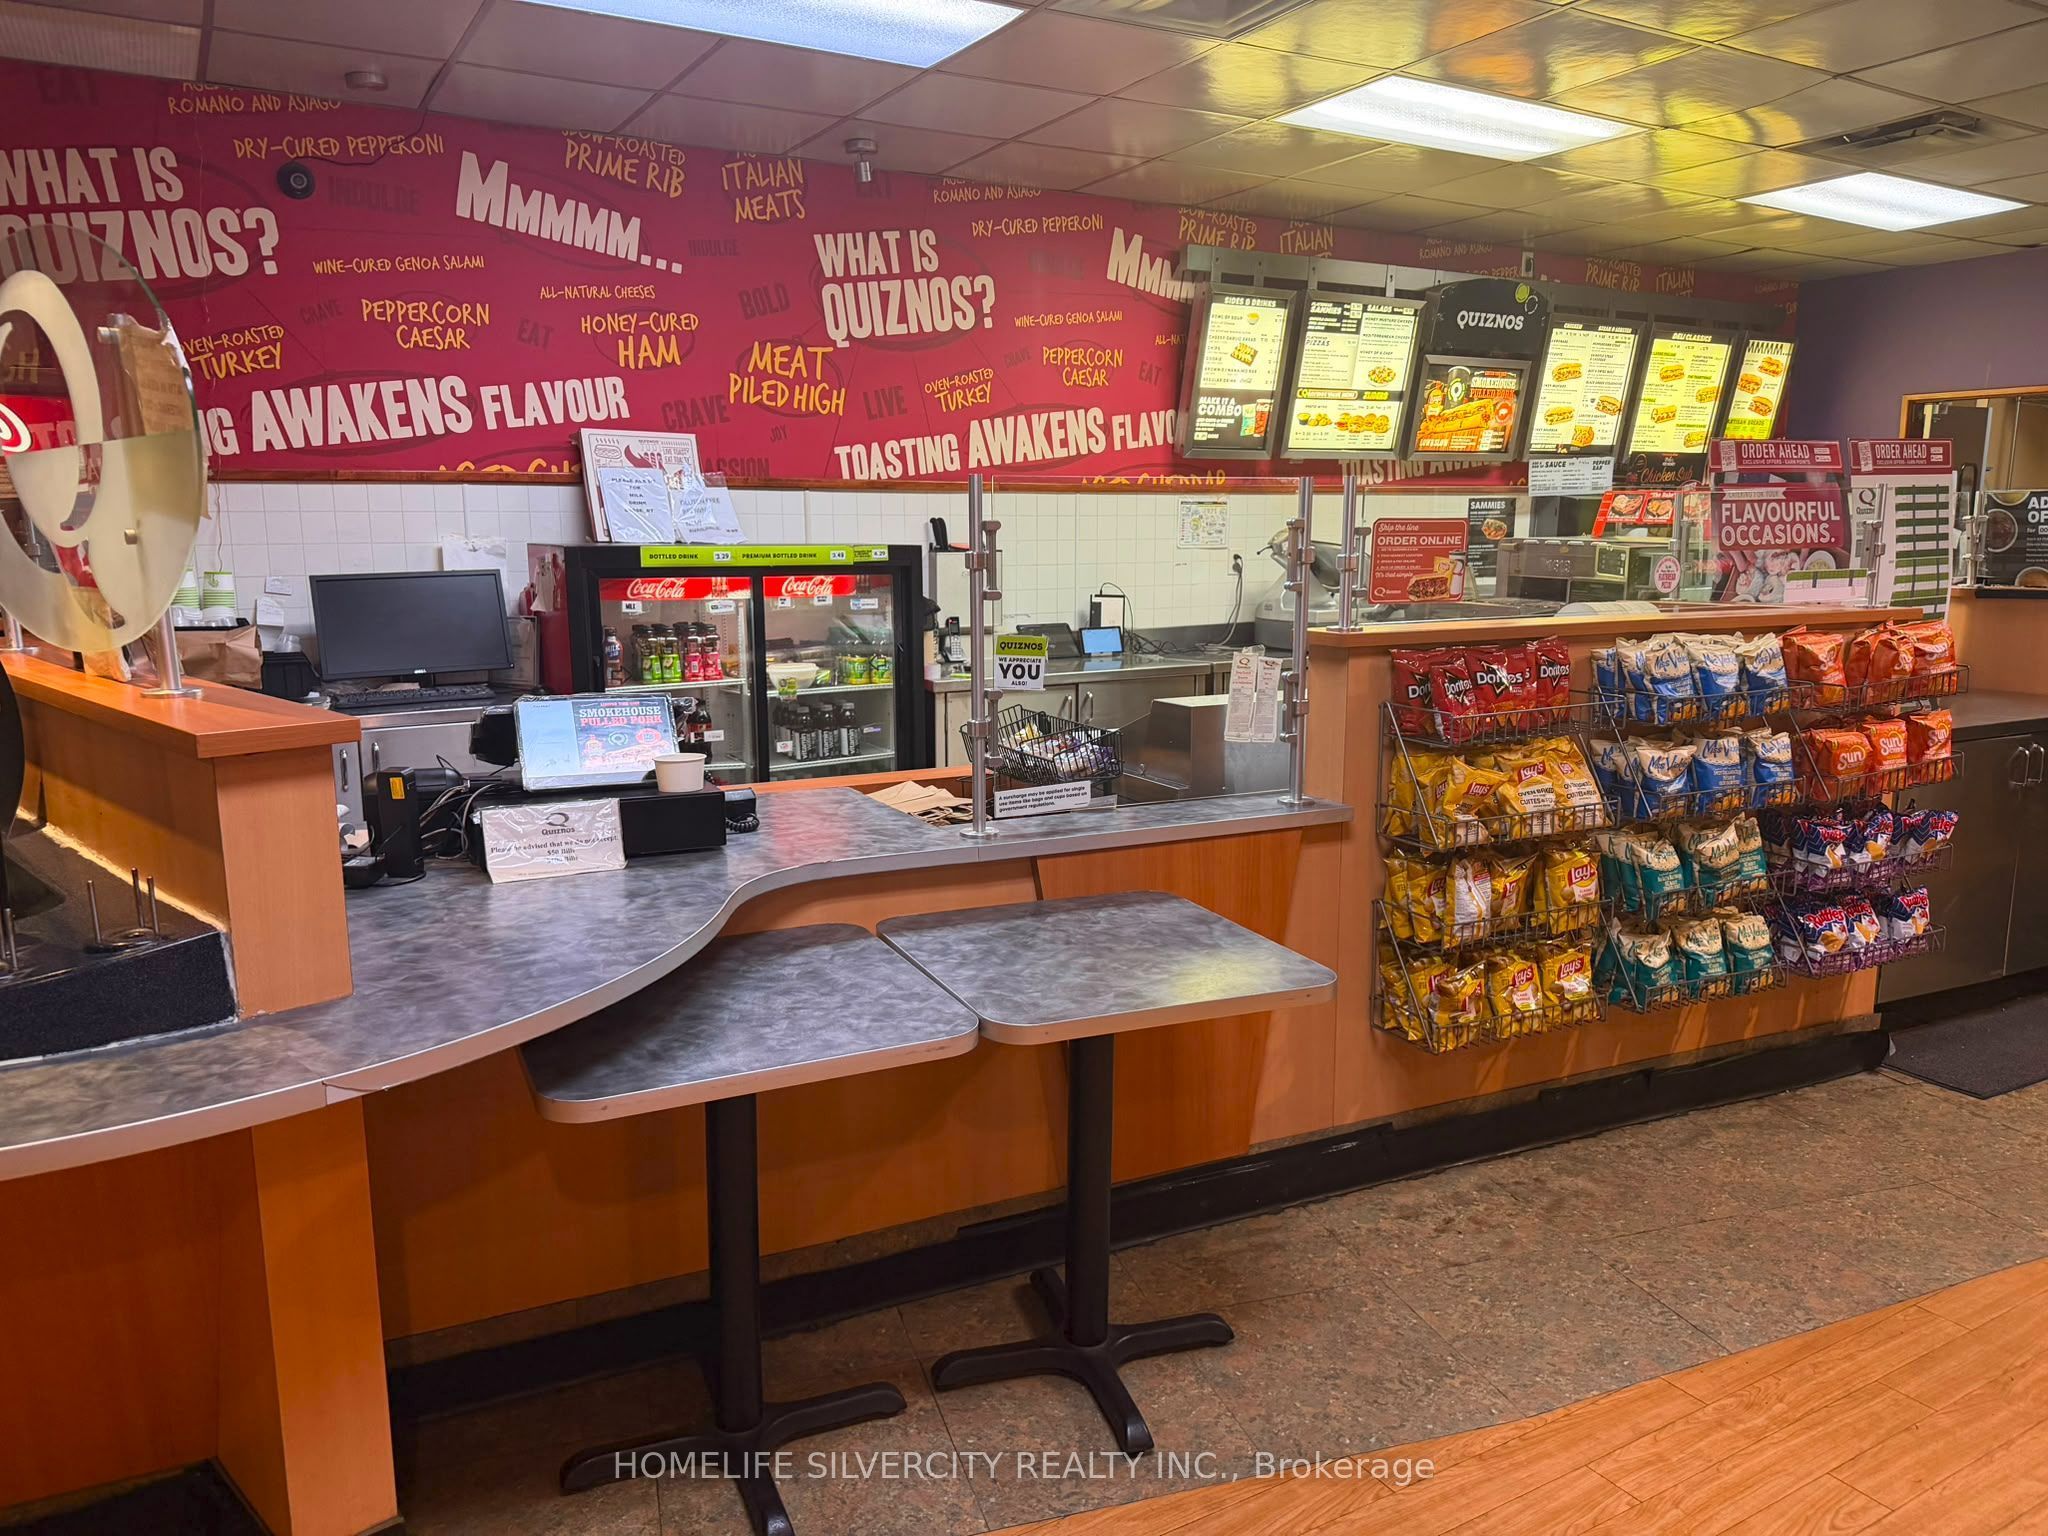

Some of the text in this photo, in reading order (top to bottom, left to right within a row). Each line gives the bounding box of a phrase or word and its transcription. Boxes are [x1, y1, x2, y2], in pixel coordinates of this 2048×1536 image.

[168, 97, 243, 114] ROMANO
[252, 96, 280, 112] AND
[233, 134, 444, 160] DRY-CURED PEPPERONI
[132, 147, 184, 202] IS
[565, 140, 687, 198] PRIME RIB
[721, 158, 804, 191] ITALIAN
[933, 188, 981, 203] ROMANO
[984, 186, 1004, 199] AND
[734, 190, 806, 223] MEATS
[971, 213, 1103, 238] DRY-CURED PEPPERONI
[1279, 226, 1334, 254] ITALIAN
[814, 229, 939, 277] WHAT IS
[313, 255, 485, 275] WINE-CURED GENOA SALAMI
[1585, 263, 1618, 289] PRIME
[1655, 270, 1694, 293] ITALIAN
[540, 284, 656, 300] ALL-NATURAL CHEESES
[361, 298, 490, 325] PEPPERCORN
[738, 286, 791, 321] BOLD
[1367, 305, 1392, 313] SALADS
[581, 311, 699, 336] HONEY-CURED
[1014, 311, 1123, 327] WINE-CURED GENOA SALAMI
[1457, 310, 1524, 331] QUIZNOS
[396, 326, 470, 350] CAESAR
[191, 342, 282, 381] TURKEY
[618, 334, 682, 369] HAM
[748, 341, 834, 381] MEAT
[1042, 346, 1123, 368] PEPPERCORN
[925, 369, 994, 393] OVEN-ROASTED
[1062, 367, 1109, 386] CAESAR
[729, 372, 847, 417] PILED HIGH
[862, 385, 906, 420] LIVE
[935, 386, 992, 413] TURKEY
[252, 375, 473, 452] AWAKENS
[480, 376, 631, 430] FLAVOUR
[661, 394, 731, 432] CRAVE
[1198, 403, 1242, 417] COMBO
[834, 408, 1105, 480] TOASTING AWAKENS
[1741, 444, 1775, 459] ORDER
[1779, 444, 1810, 460] AHEAD
[1875, 444, 1927, 459] ORDER AHEAD
[1470, 501, 1506, 510] SAMMIES
[1721, 501, 1840, 524] FLAVOURFUL
[1377, 535, 1462, 546] ORDER ONLINE
[1721, 523, 1836, 547] OCCASIONS.
[742, 552, 770, 560] PREMIUM
[798, 551, 817, 559] DRINK
[627, 578, 686, 599] Coca-Cola
[781, 575, 833, 596] Coca-Cola
[1000, 642, 1043, 651] QUIZNOS
[999, 664, 1041, 680] YOU
[1540, 663, 1570, 679] Doritos
[1444, 678, 1473, 696] Doritos
[579, 706, 662, 718] SMOKEHOUSE
[581, 715, 663, 727] PULLED PORK
[1880, 737, 1903, 755] Sun
[1928, 729, 1948, 747] Sun
[1520, 763, 1545, 780] Lay's
[1837, 752, 1863, 771] Sun
[1003, 792, 1027, 800] surcharge
[1468, 782, 1491, 795] Lay's
[998, 805, 1028, 813] government
[522, 842, 548, 851] advised
[549, 840, 563, 848] that
